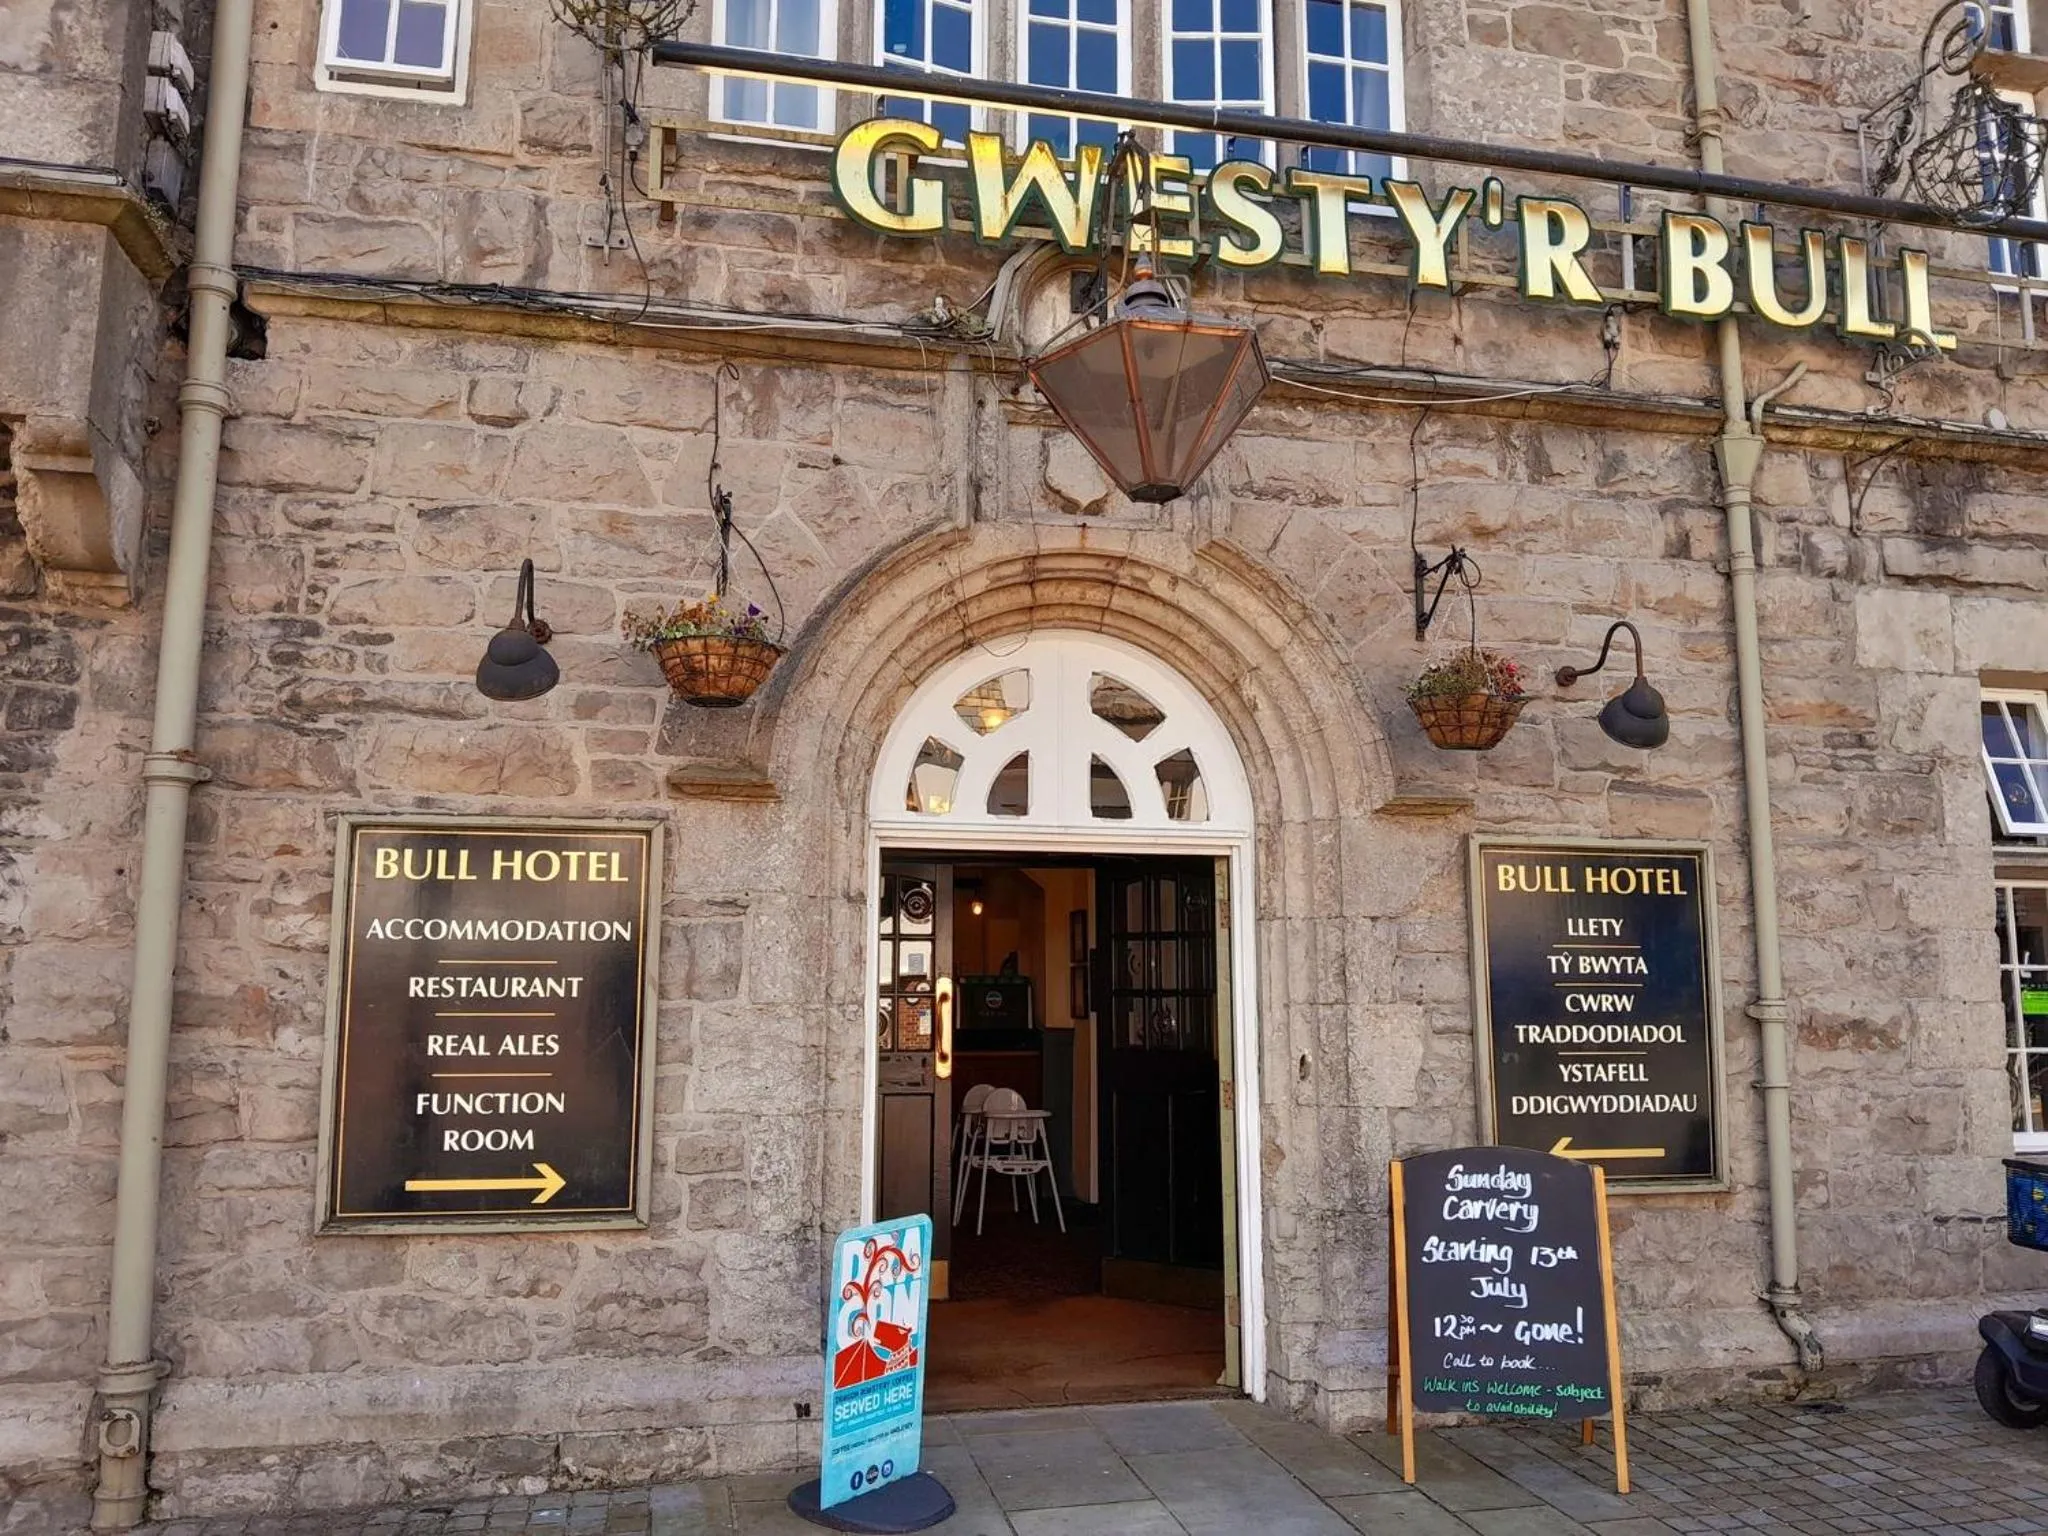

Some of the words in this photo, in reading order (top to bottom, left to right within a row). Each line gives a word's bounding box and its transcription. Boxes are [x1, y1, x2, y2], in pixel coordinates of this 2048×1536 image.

[832, 117, 1602, 301] GWESTY'R
[1663, 209, 1957, 349] BULL
[374, 848, 477, 880] BULL
[491, 850, 629, 882] HOTEL
[1498, 864, 1575, 893] BULL
[1585, 867, 1688, 896] HOTEL
[366, 918, 632, 942] ACCOMMODATION
[1567, 918, 1624, 937] LLETY
[1579, 955, 1649, 975] BWYTA
[408, 976, 583, 998] RESTAURANT
[1565, 994, 1635, 1012] CWRW
[427, 1034, 490, 1056] REAL
[498, 1034, 560, 1056] ALES
[1514, 1025, 1687, 1044] TRADDODIADOL
[1558, 1063, 1649, 1082] YSTAFELL
[416, 1092, 565, 1115] FUNCTION
[1511, 1094, 1697, 1115] DDIGWYDDIADAU
[443, 1129, 535, 1151] ROOM
[1445, 1164, 1532, 1199] Sunday
[1442, 1195, 1539, 1233] Carvery
[1421, 1235, 1514, 1274] Starting
[1530, 1246, 1578, 1267] 13th
[1470, 1276, 1528, 1308] July
[1514, 1306, 1584, 1345] Gone!
[1443, 1352, 1476, 1369] Call
[1479, 1354, 1495, 1367] to
[834, 1393, 880, 1422] SERVED
[884, 1382, 914, 1406] HERE
[1466, 1399, 1481, 1411] to
